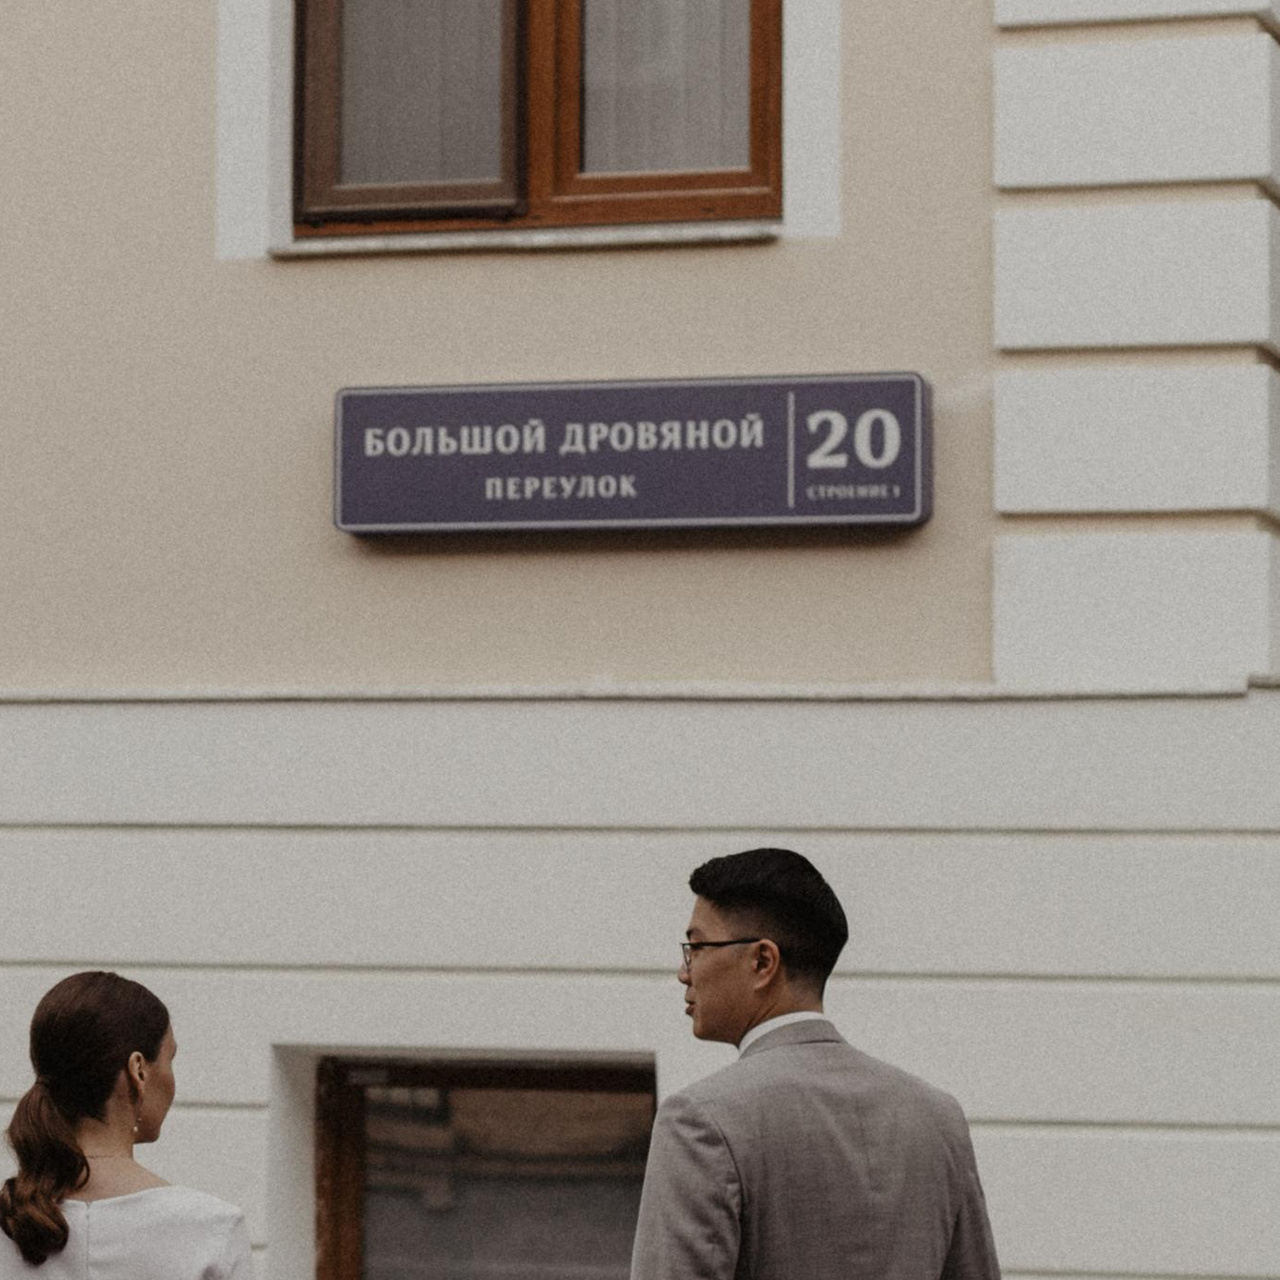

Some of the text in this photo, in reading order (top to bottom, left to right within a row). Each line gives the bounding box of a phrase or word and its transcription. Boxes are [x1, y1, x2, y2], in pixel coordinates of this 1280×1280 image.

[364, 413, 764, 456] БОЛЬШОЙ ДРОВЯНОЙ
[806, 408, 901, 469] 20
[485, 475, 637, 500] ПЕРЕУЛОК
